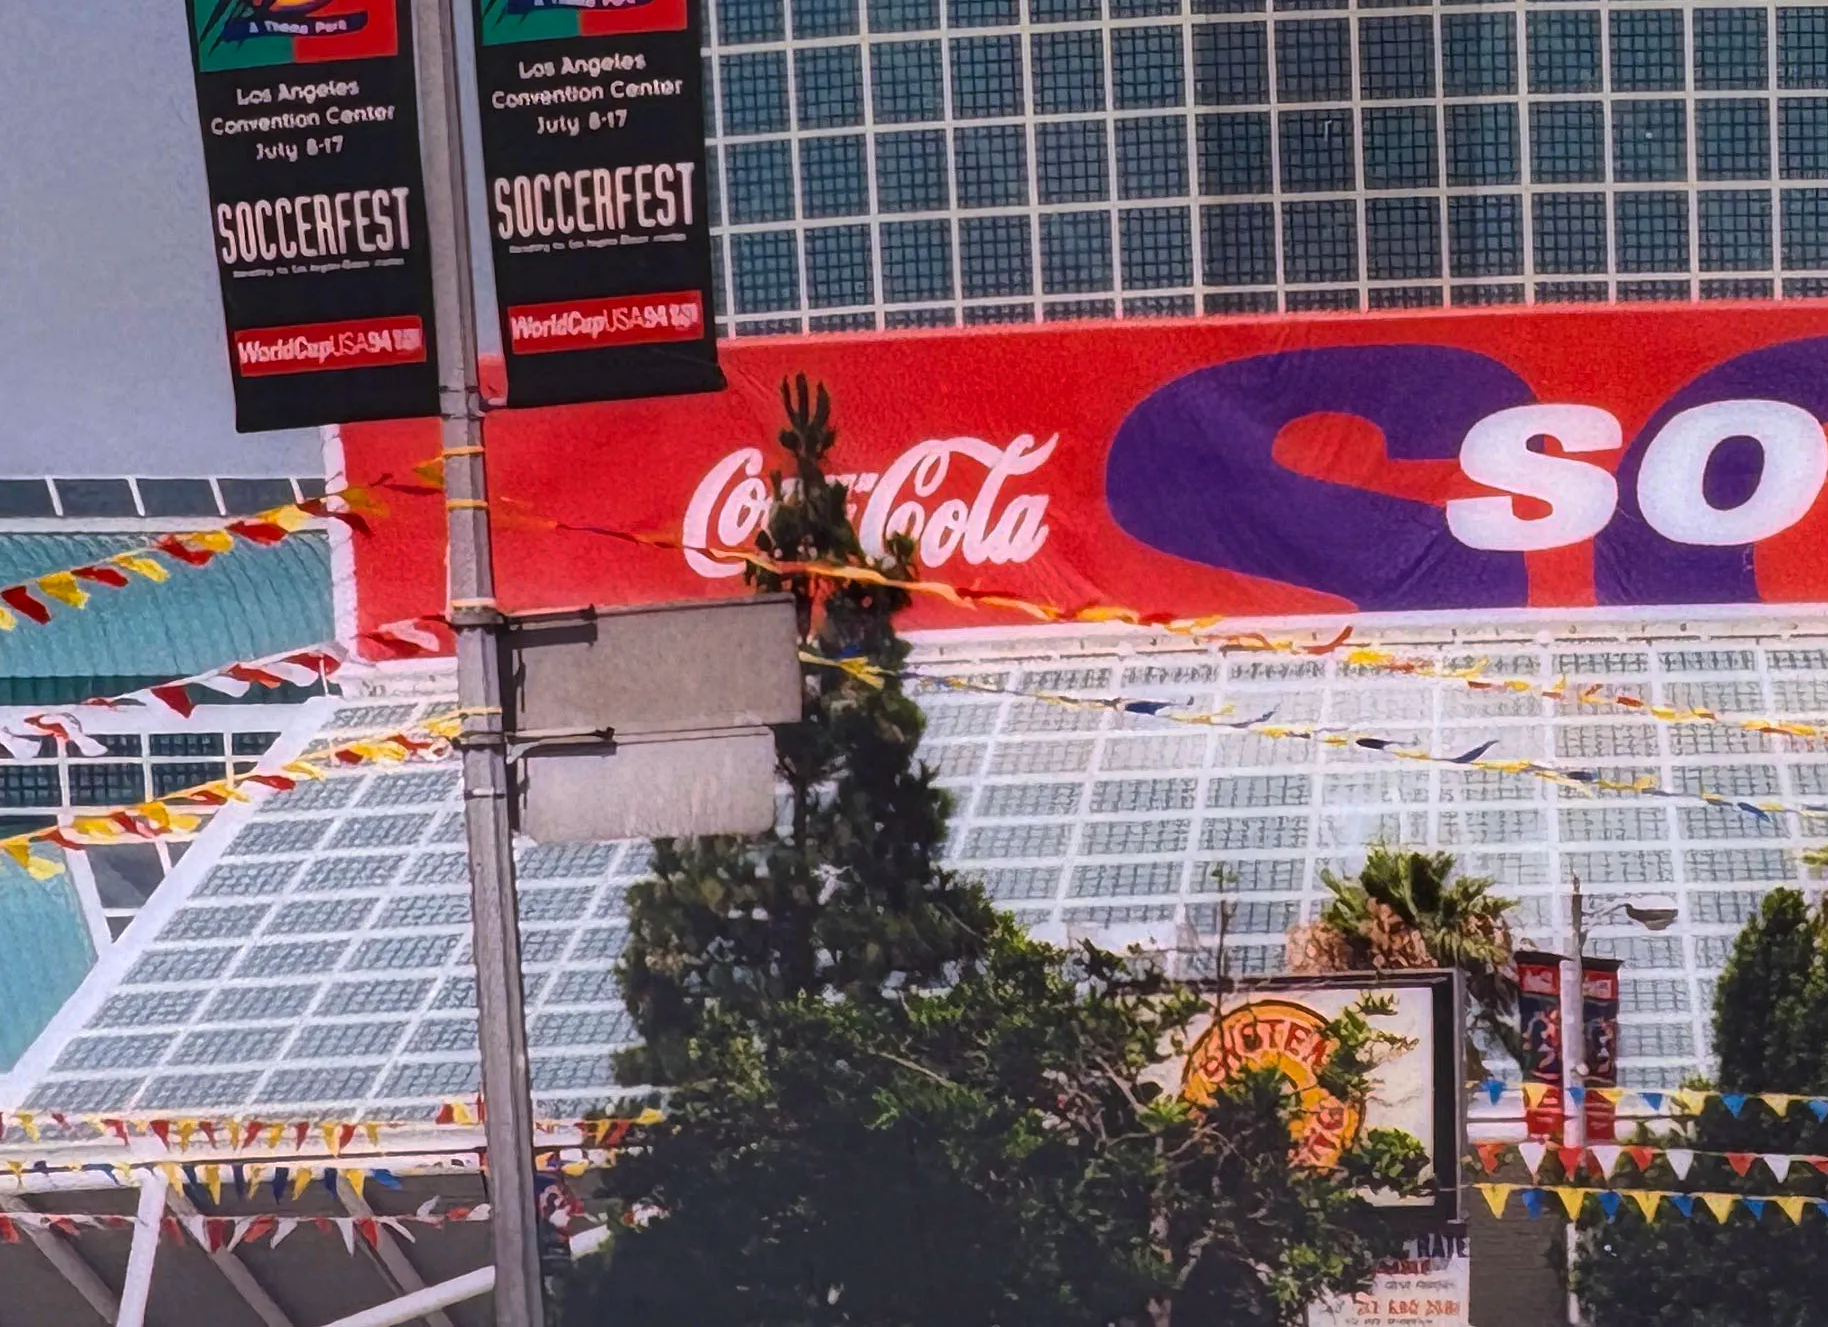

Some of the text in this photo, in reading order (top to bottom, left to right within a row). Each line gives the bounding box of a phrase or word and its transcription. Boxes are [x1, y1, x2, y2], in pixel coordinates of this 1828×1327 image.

[518, 53, 647, 79] Los Angeles
[236, 80, 360, 105] Los Angeles
[491, 78, 684, 109] Convention Center
[211, 105, 396, 135] Convention Center
[537, 108, 628, 136] July 8-17
[256, 134, 344, 162] July 8-17
[494, 162, 696, 240] SOCCERFEST
[217, 186, 411, 265] SOCCERFEST
